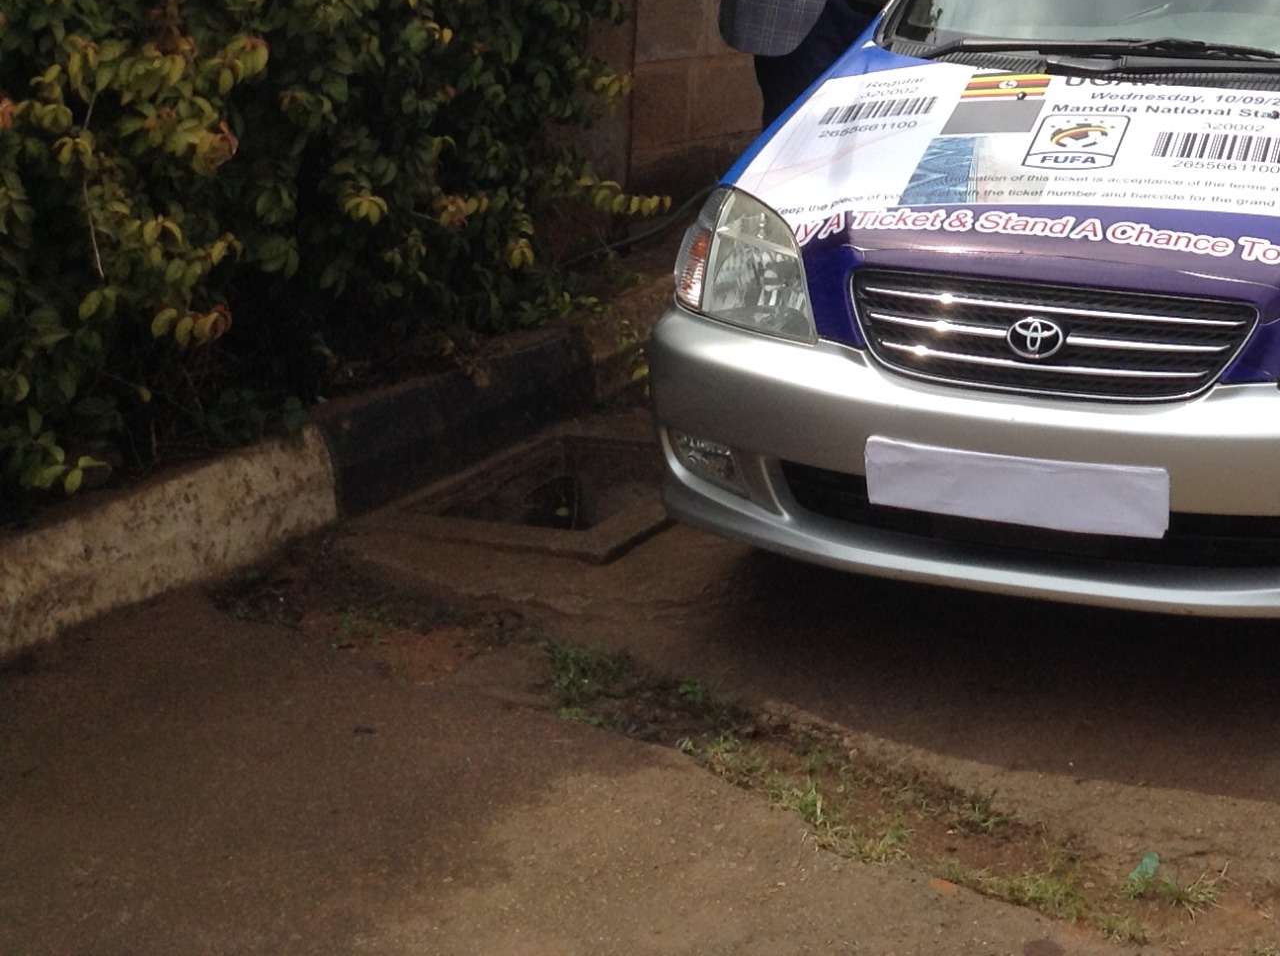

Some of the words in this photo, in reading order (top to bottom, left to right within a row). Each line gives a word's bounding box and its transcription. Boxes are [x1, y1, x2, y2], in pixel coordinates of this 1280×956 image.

[866, 77, 927, 89] Regular
[860, 87, 920, 99] 320002
[1091, 92, 1206, 104] Wednesday,
[1051, 104, 1138, 114] Mandela
[1145, 105, 1232, 118] National
[818, 120, 918, 139] 2655661100
[1202, 122, 1265, 133] 320002
[1039, 155, 1097, 165] FUFA
[1171, 159, 1280, 175] 2655661100
[1010, 174, 1025, 182] of
[1027, 174, 1050, 182] this
[1054, 175, 1089, 183] ticket
[1187, 179, 1200, 187] of
[1204, 180, 1226, 188] the
[1229, 182, 1267, 191] terms
[980, 189, 1005, 197] the
[1008, 189, 1044, 197] ticket
[1046, 190, 1098, 198] number
[1101, 191, 1127, 199] and
[1189, 194, 1207, 202] for
[1211, 195, 1233, 204] the
[1235, 198, 1275, 208] grand
[821, 211, 843, 238] A
[854, 209, 943, 229] Ticket
[946, 210, 970, 230] &
[979, 212, 1072, 236] Stand
[1073, 220, 1100, 239] A
[1110, 223, 1232, 254] Chance
